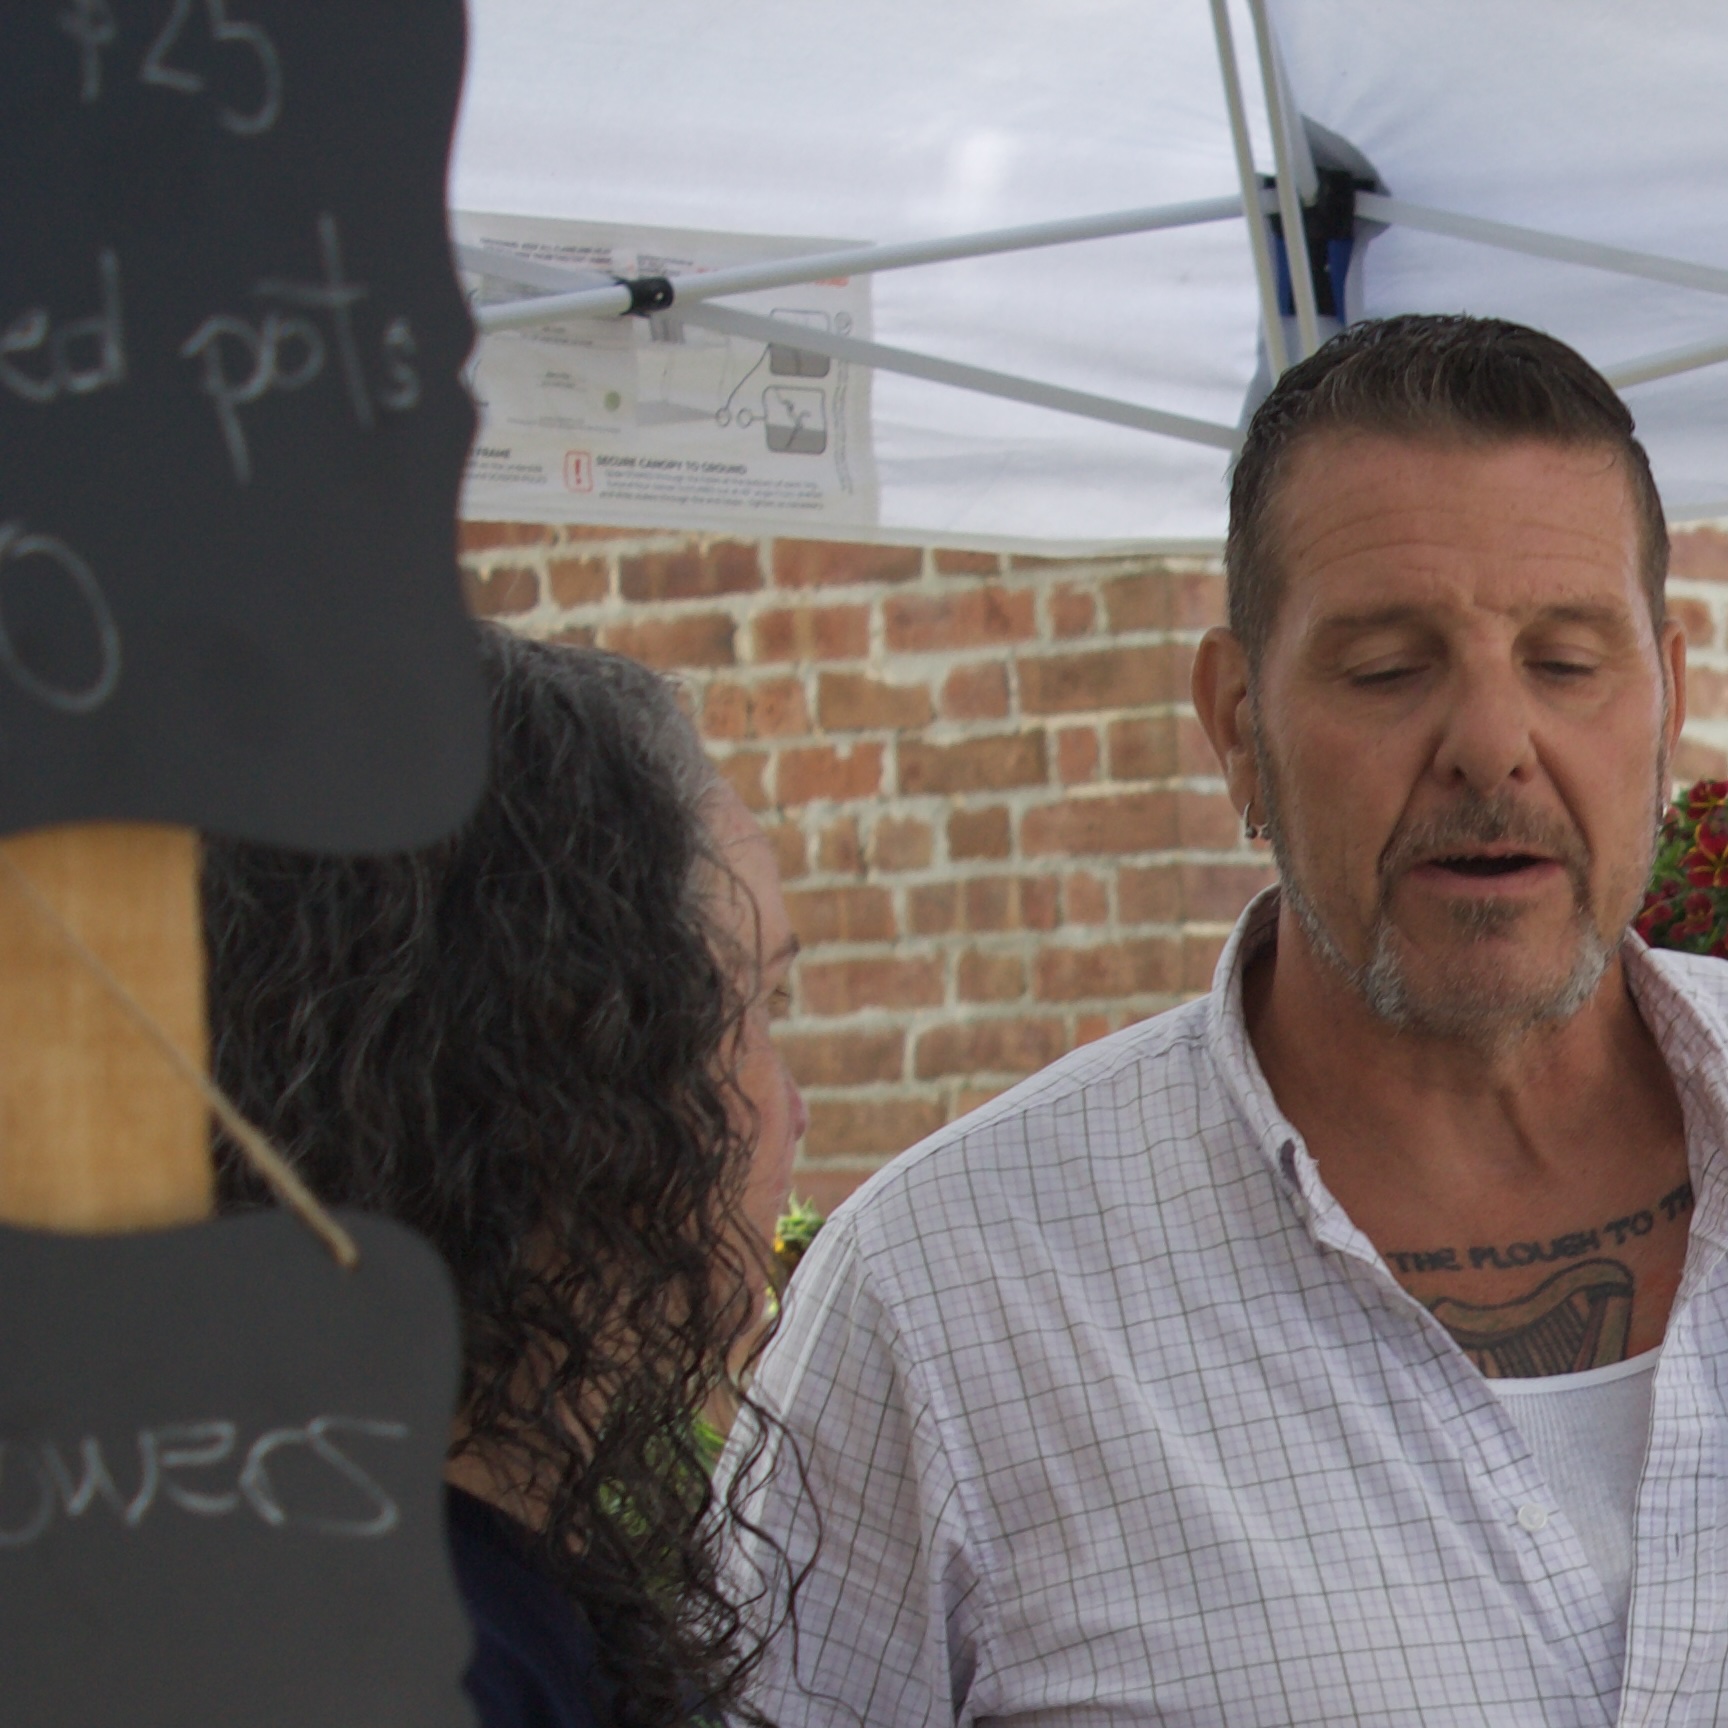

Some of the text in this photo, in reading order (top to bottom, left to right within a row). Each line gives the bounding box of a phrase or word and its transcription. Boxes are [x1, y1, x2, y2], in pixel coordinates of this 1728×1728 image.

[181, 212, 421, 487] pots
[1387, 1248, 1461, 1273] THE
[1604, 1211, 1653, 1246] TO
